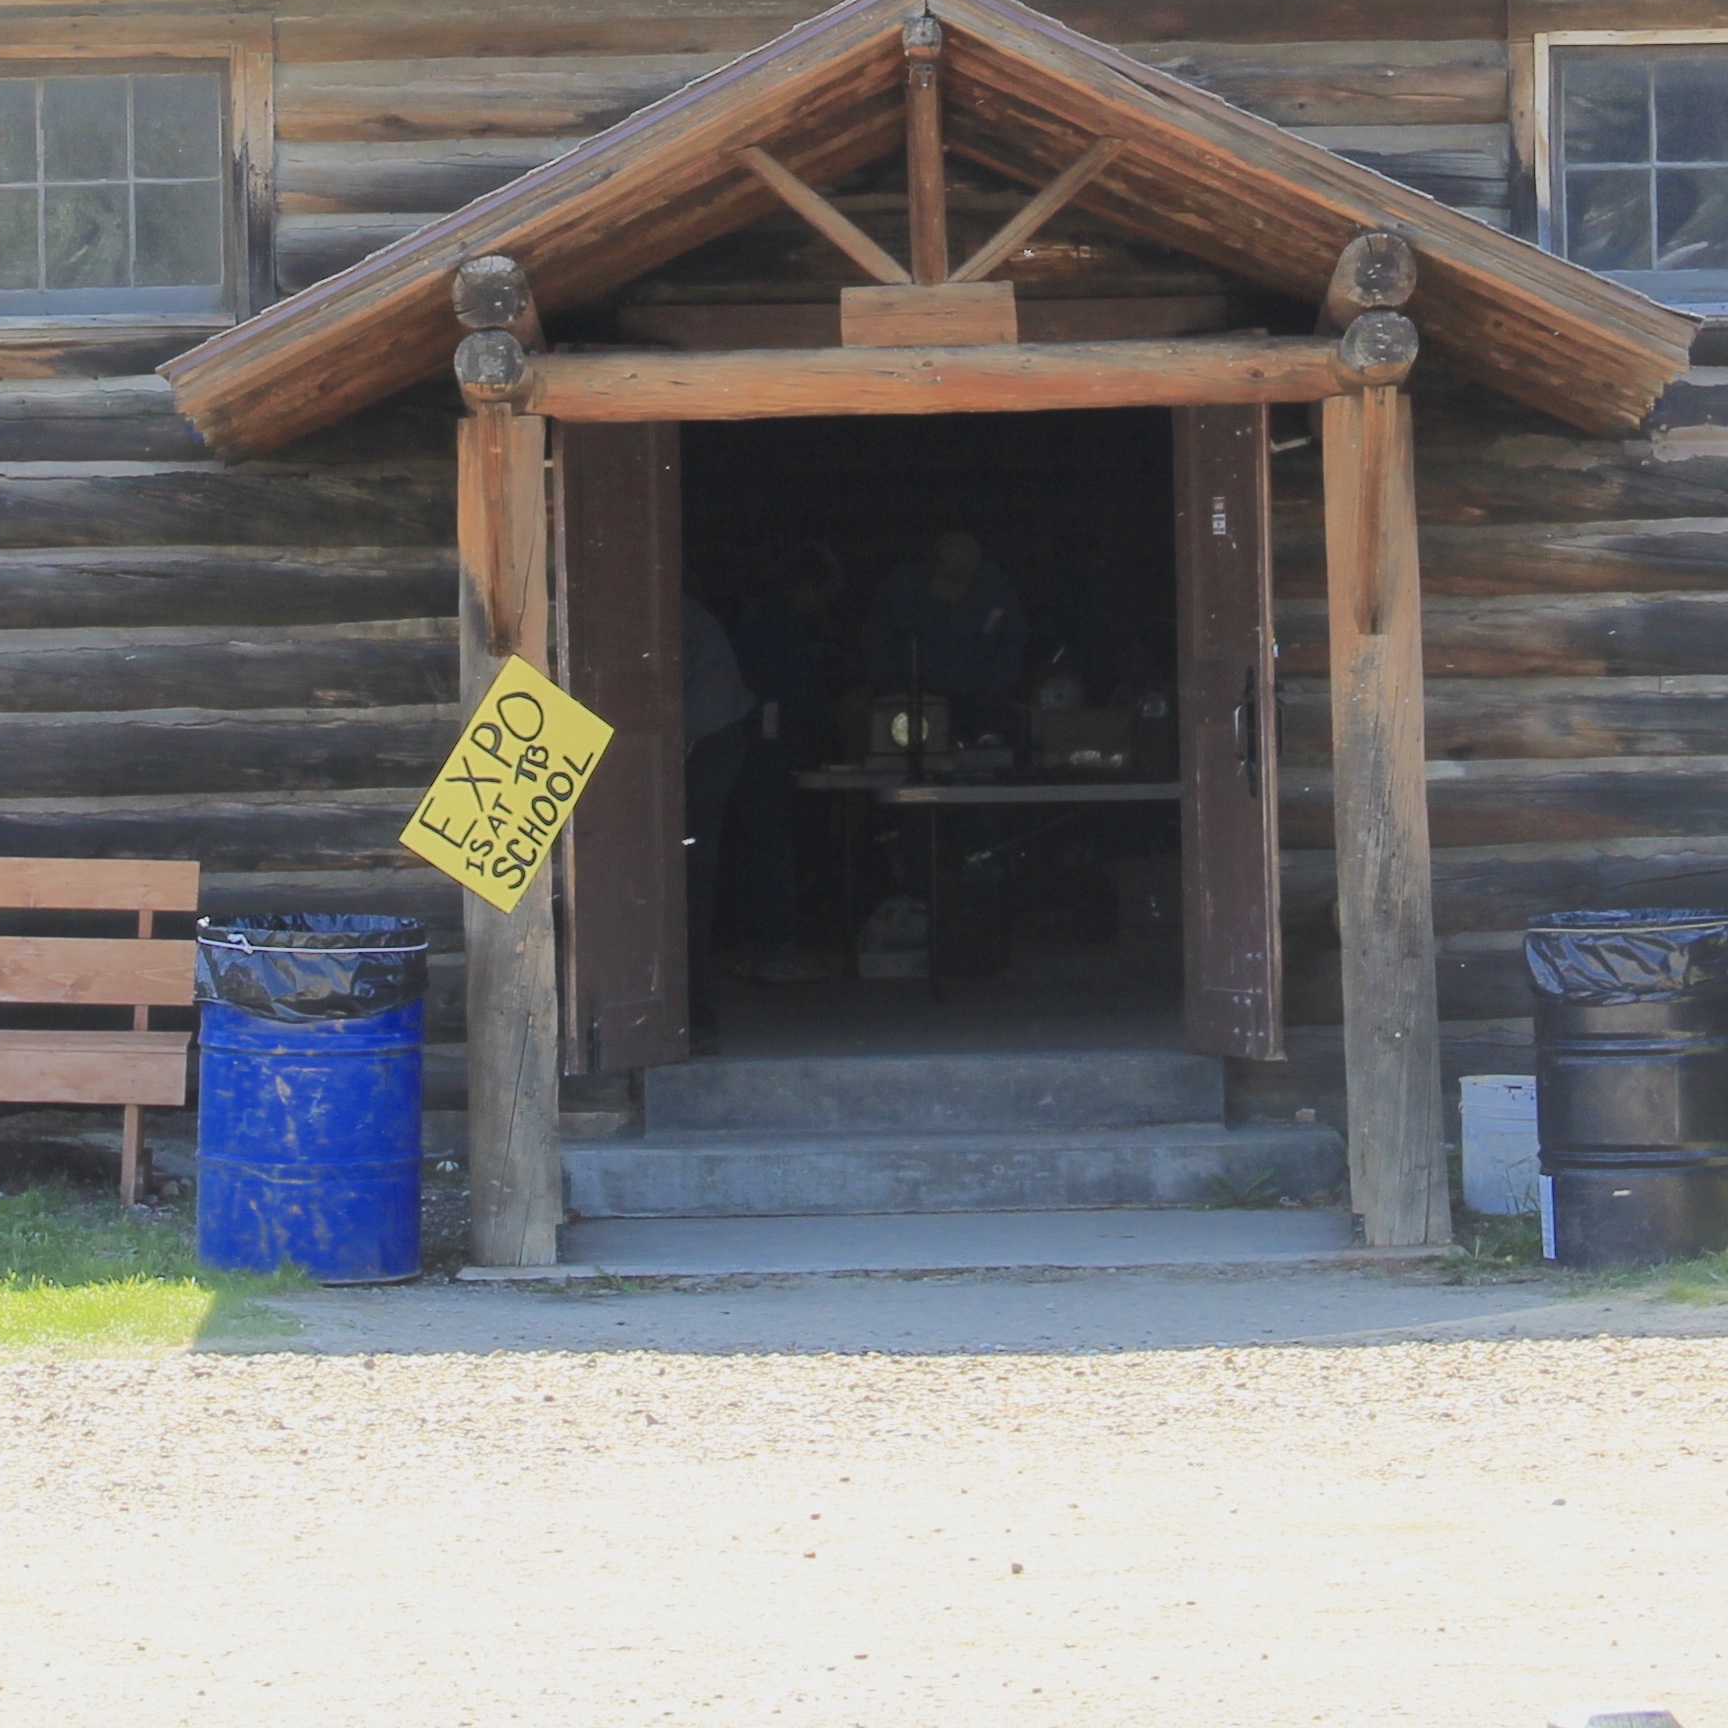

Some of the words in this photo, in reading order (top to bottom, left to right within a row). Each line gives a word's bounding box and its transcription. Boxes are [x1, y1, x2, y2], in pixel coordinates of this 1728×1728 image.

[419, 692, 544, 848] EXPO
[465, 839, 494, 876] IS
[487, 793, 513, 838] AT
[491, 752, 594, 889] SCHOOL
